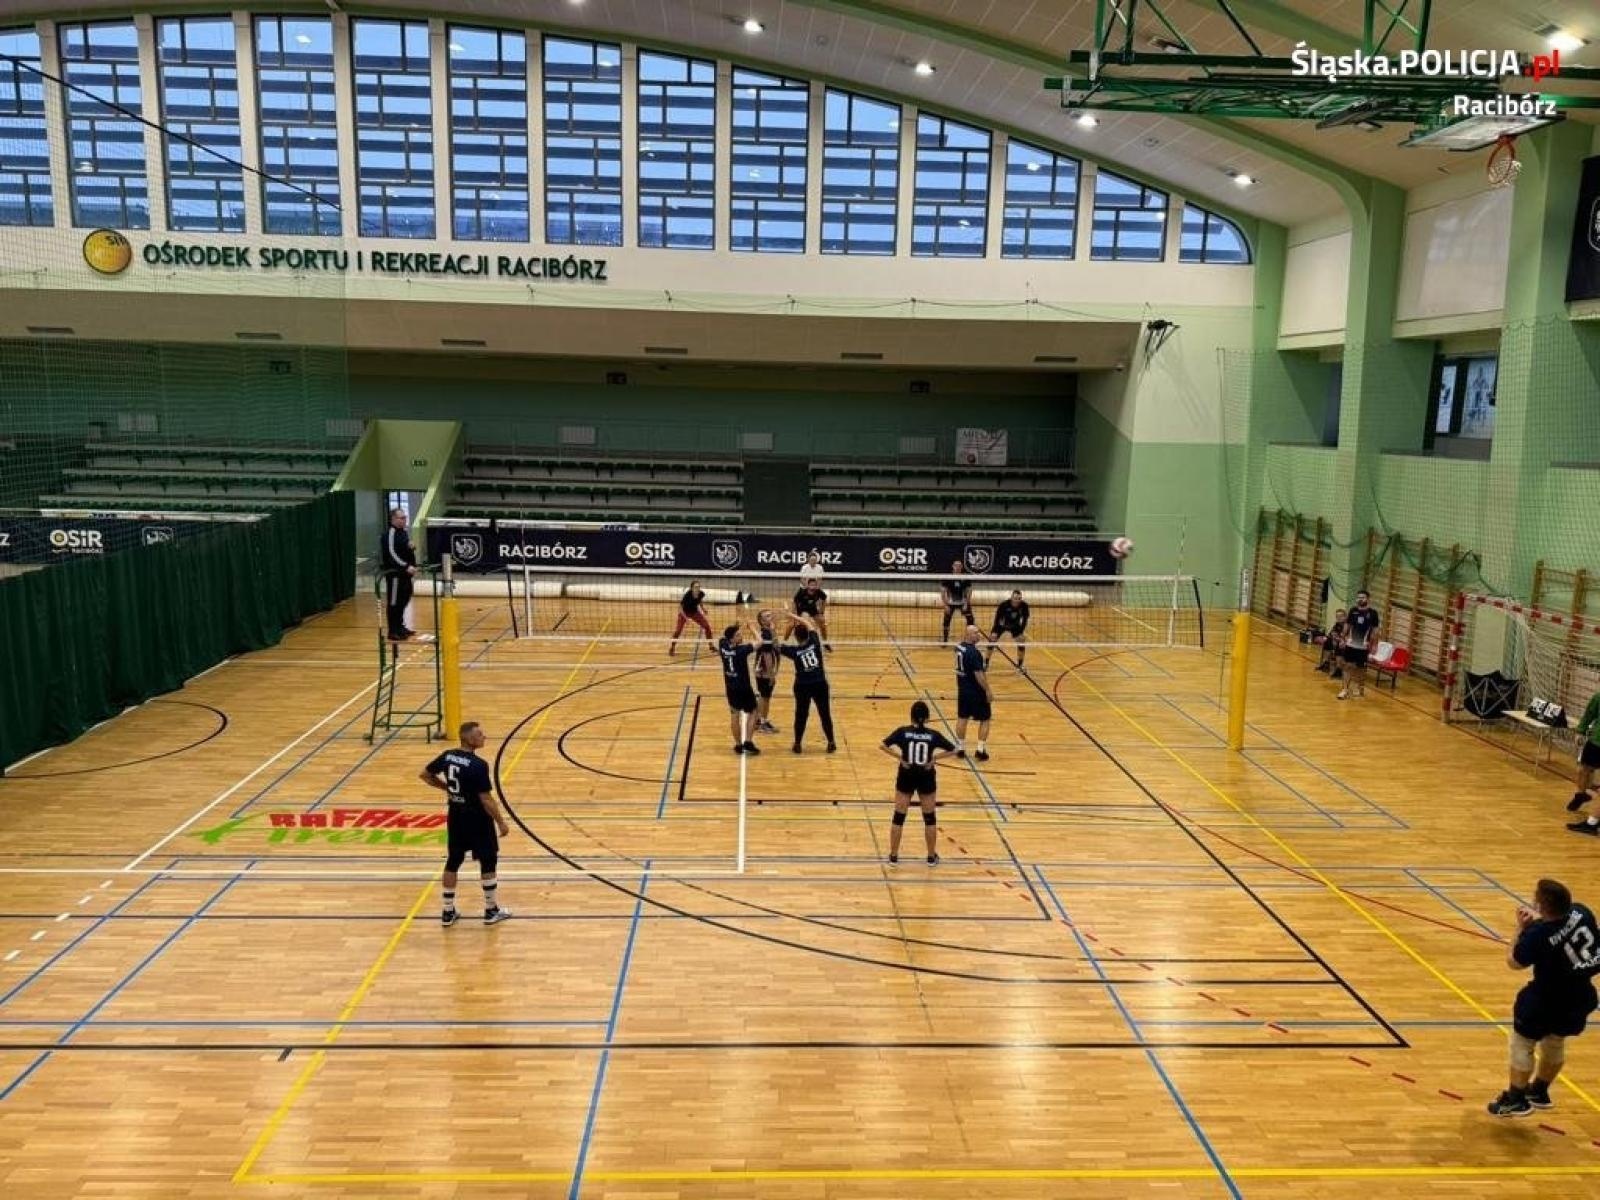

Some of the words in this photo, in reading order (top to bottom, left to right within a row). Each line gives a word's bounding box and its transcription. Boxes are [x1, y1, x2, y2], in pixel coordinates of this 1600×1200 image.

[143, 242, 251, 267] OŚRODEK
[260, 247, 348, 270] SPORTU
[357, 252, 363, 271] I
[372, 253, 489, 276] REKREACJI
[498, 255, 608, 281] RACIBÓRZ
[50, 529, 104, 548] OSiR
[499, 541, 588, 560] RACIBÓRZ
[625, 541, 675, 560] OSiR
[879, 547, 928, 565] OSiR
[1008, 552, 1094, 570] RACIBÓRZ
[800, 649, 820, 669] 18
[908, 740, 929, 765] 10
[448, 764, 461, 793] 5
